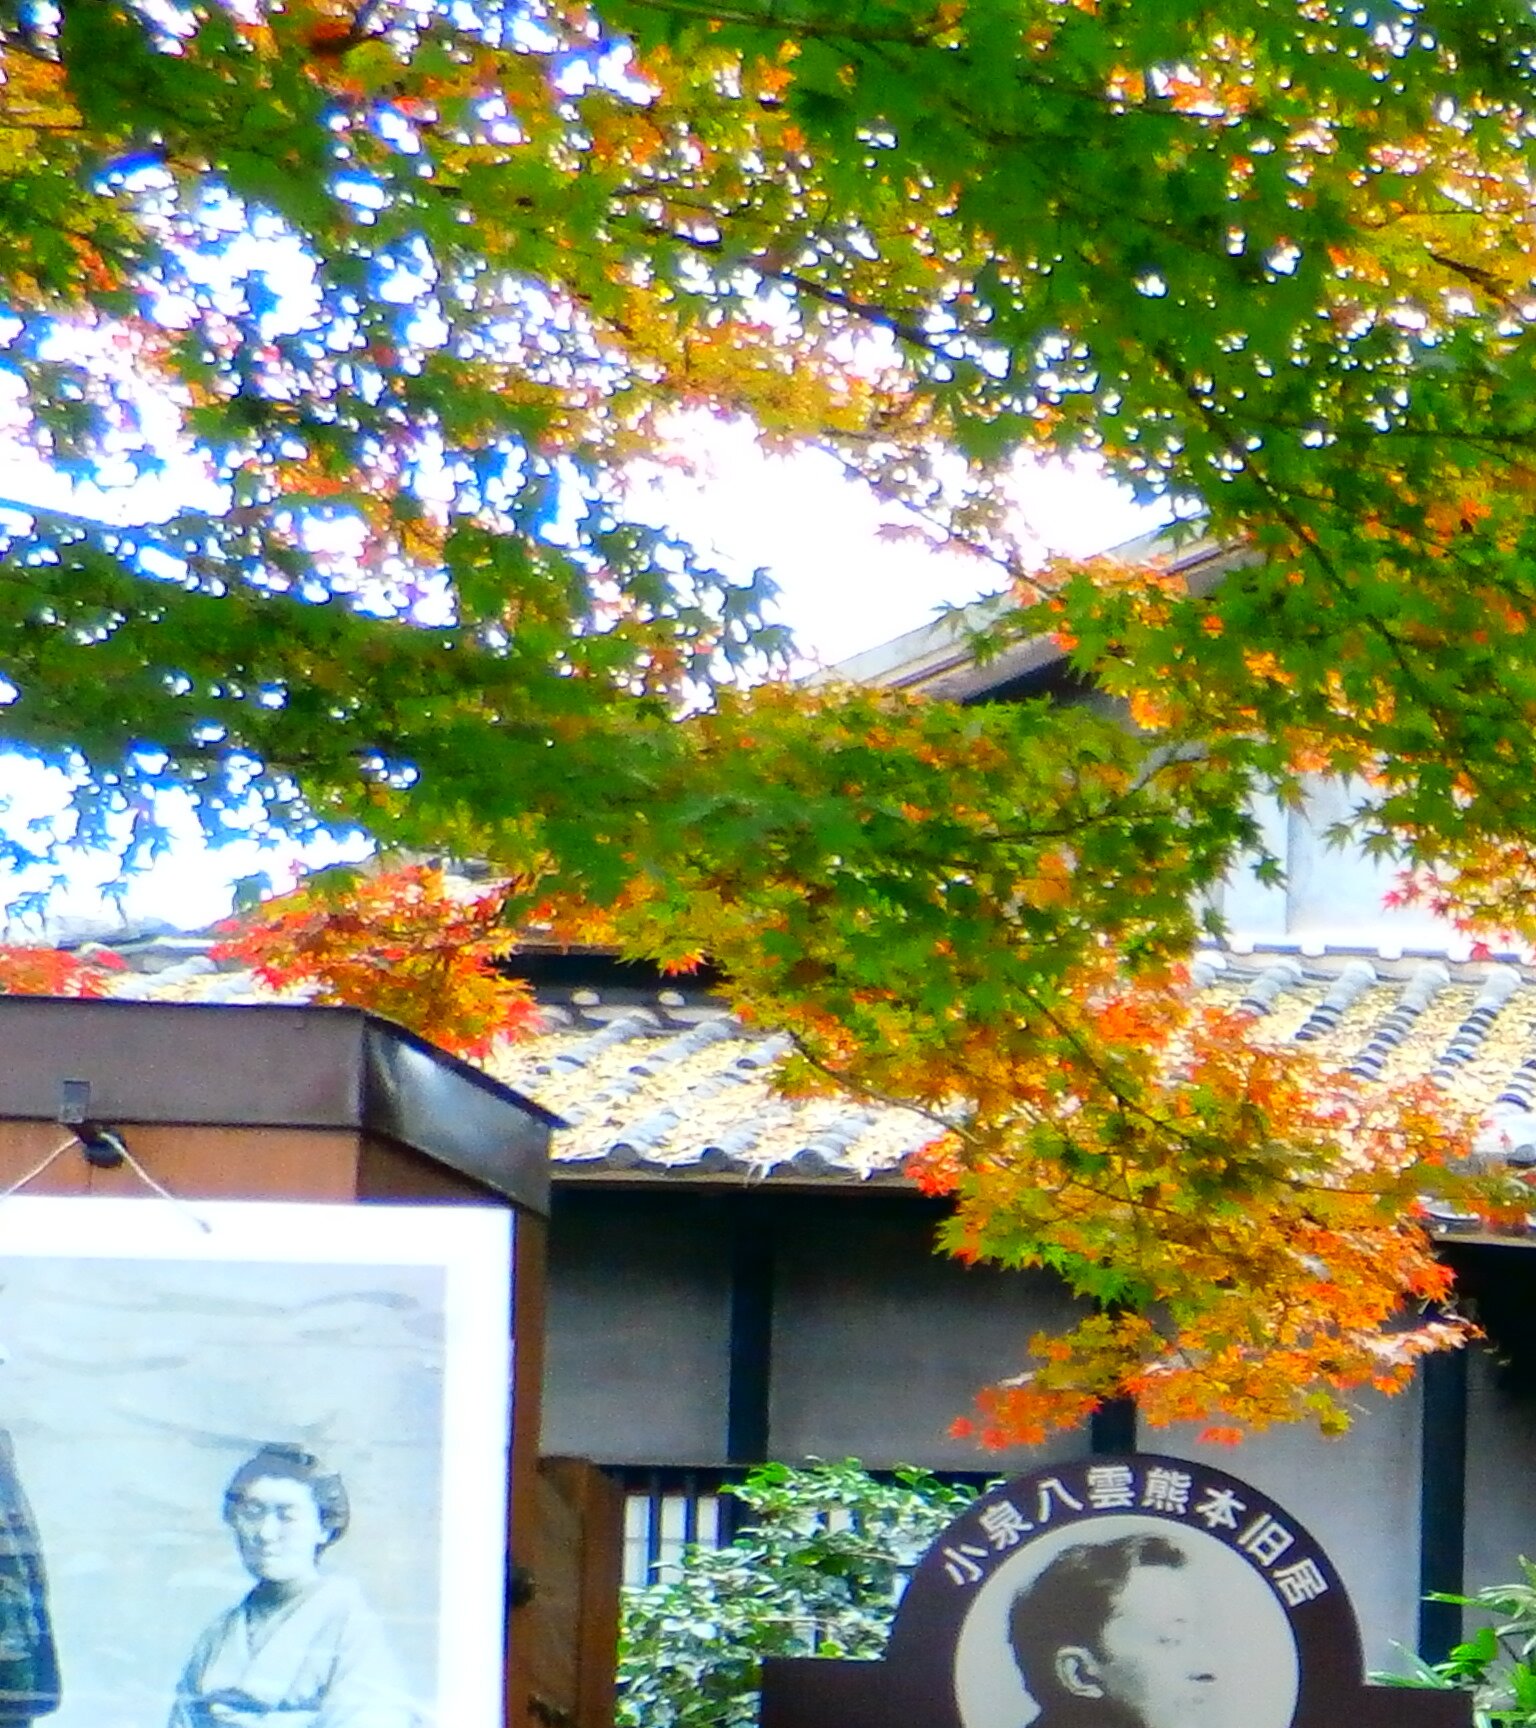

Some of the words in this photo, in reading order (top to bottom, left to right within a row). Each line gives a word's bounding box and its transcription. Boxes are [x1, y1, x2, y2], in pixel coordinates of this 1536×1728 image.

[941, 1465, 1330, 1608] 小泉八雲熊本旧居
